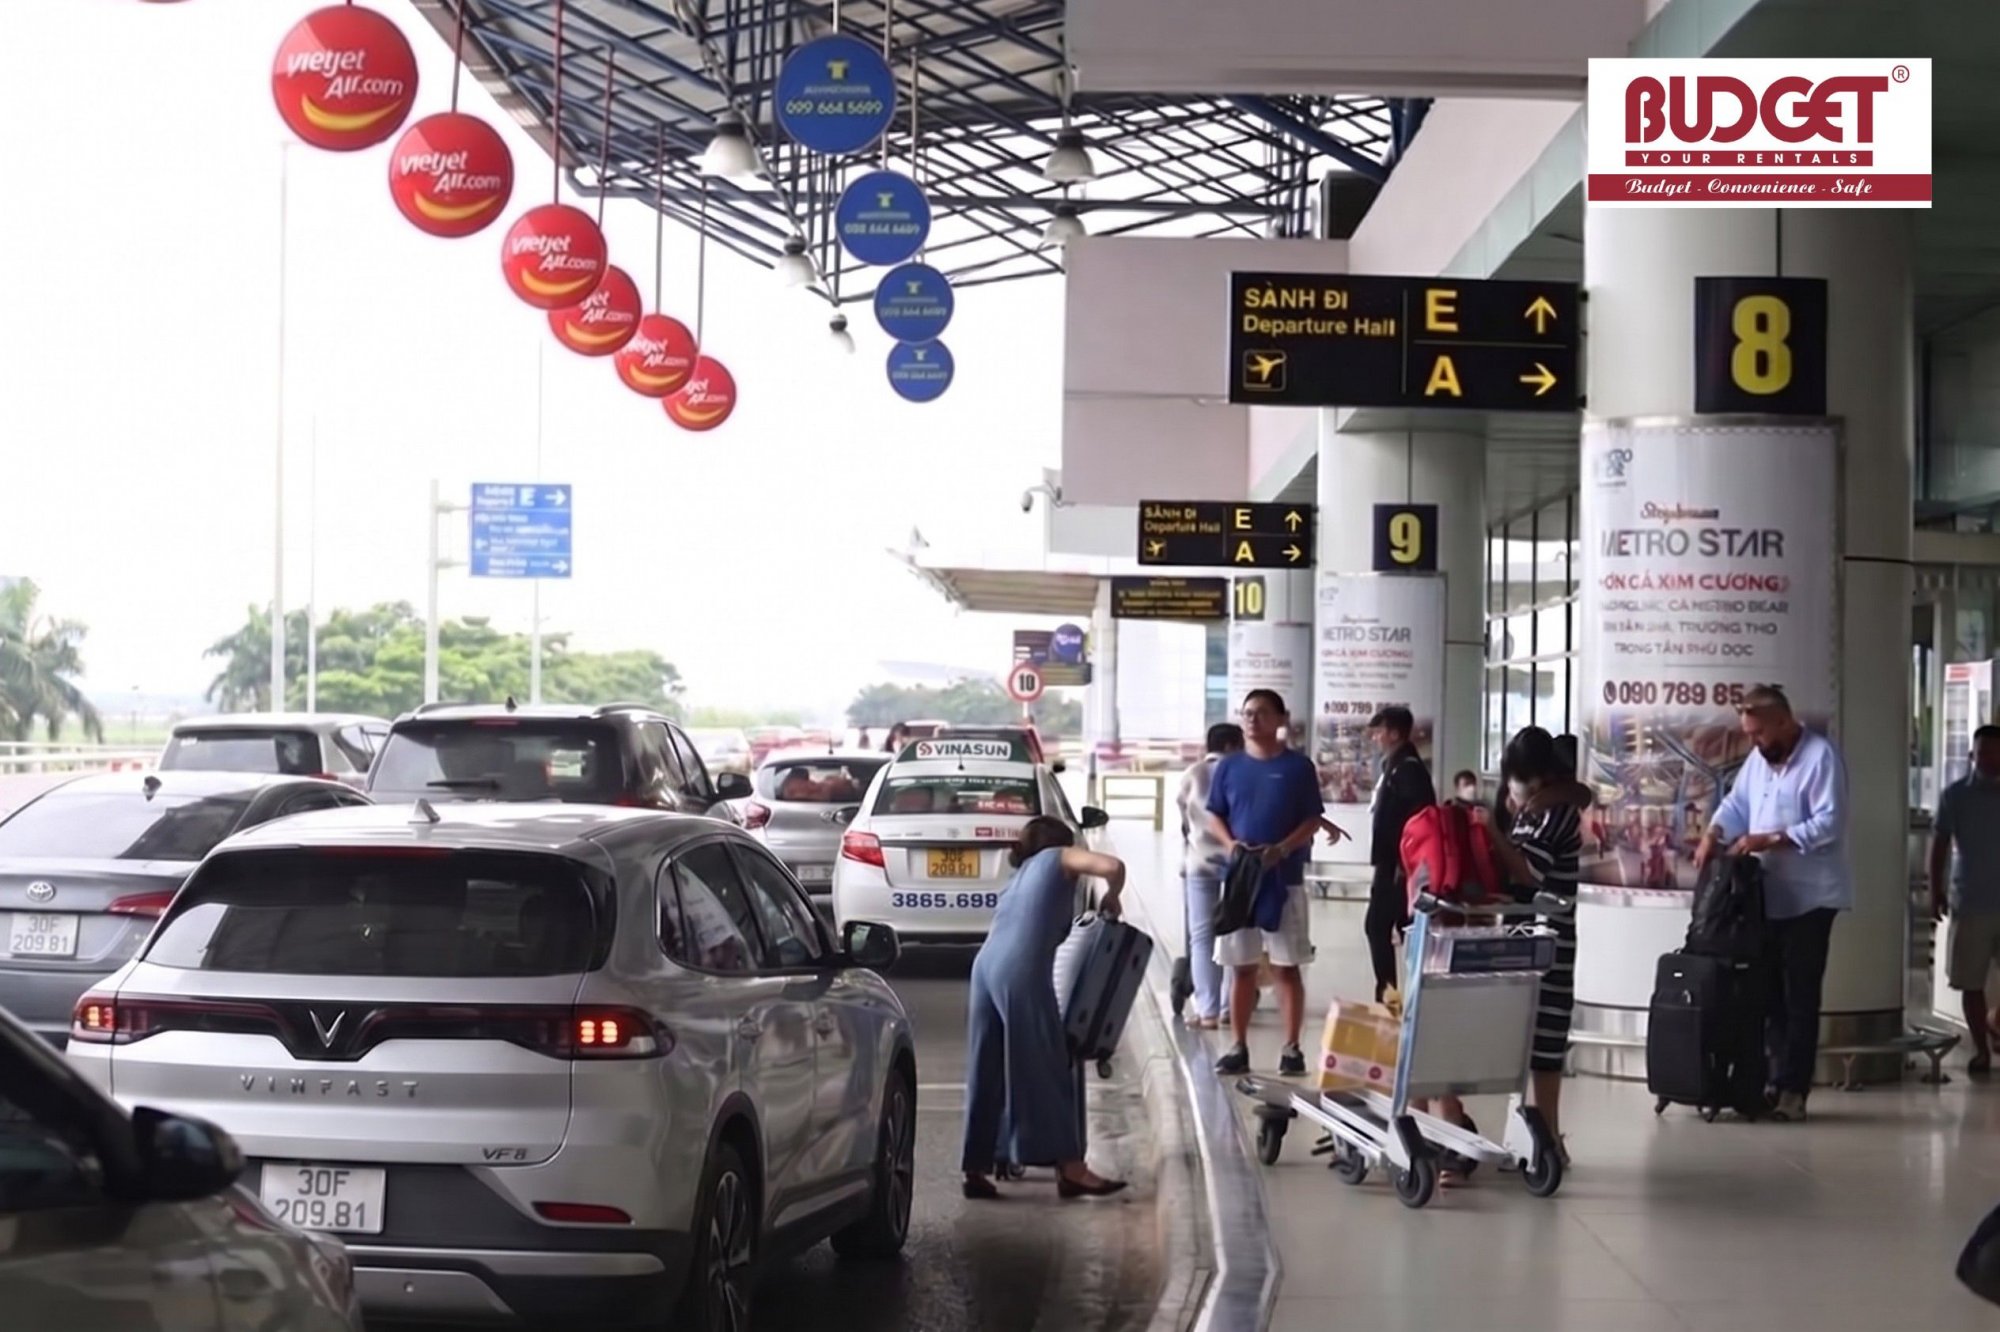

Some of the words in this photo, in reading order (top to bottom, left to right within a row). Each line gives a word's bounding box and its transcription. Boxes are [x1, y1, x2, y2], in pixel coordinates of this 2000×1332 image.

[324, 76, 403, 99] Air.com
[1324, 290, 1348, 309] ĐI
[1425, 289, 1459, 332] E
[1243, 315, 1348, 337] Departure
[1354, 318, 1396, 337] Hall
[1731, 294, 1792, 394] 8
[1424, 355, 1462, 396] A
[1235, 509, 1251, 529] E
[1389, 512, 1421, 563] 9
[1698, 529, 1784, 557] STAR
[1235, 541, 1254, 562] A
[1235, 582, 1262, 614] 10
[1019, 673, 1035, 691] 10
[1619, 682, 1657, 704] 090
[1663, 682, 1706, 705] 789
[934, 743, 1008, 756] VINASUN
[892, 893, 998, 909] 3865.698
[28, 914, 60, 933] 30F
[240, 1074, 419, 1099] VINFAST
[297, 1169, 351, 1197] 30F
[275, 1198, 365, 1229] 209.81
